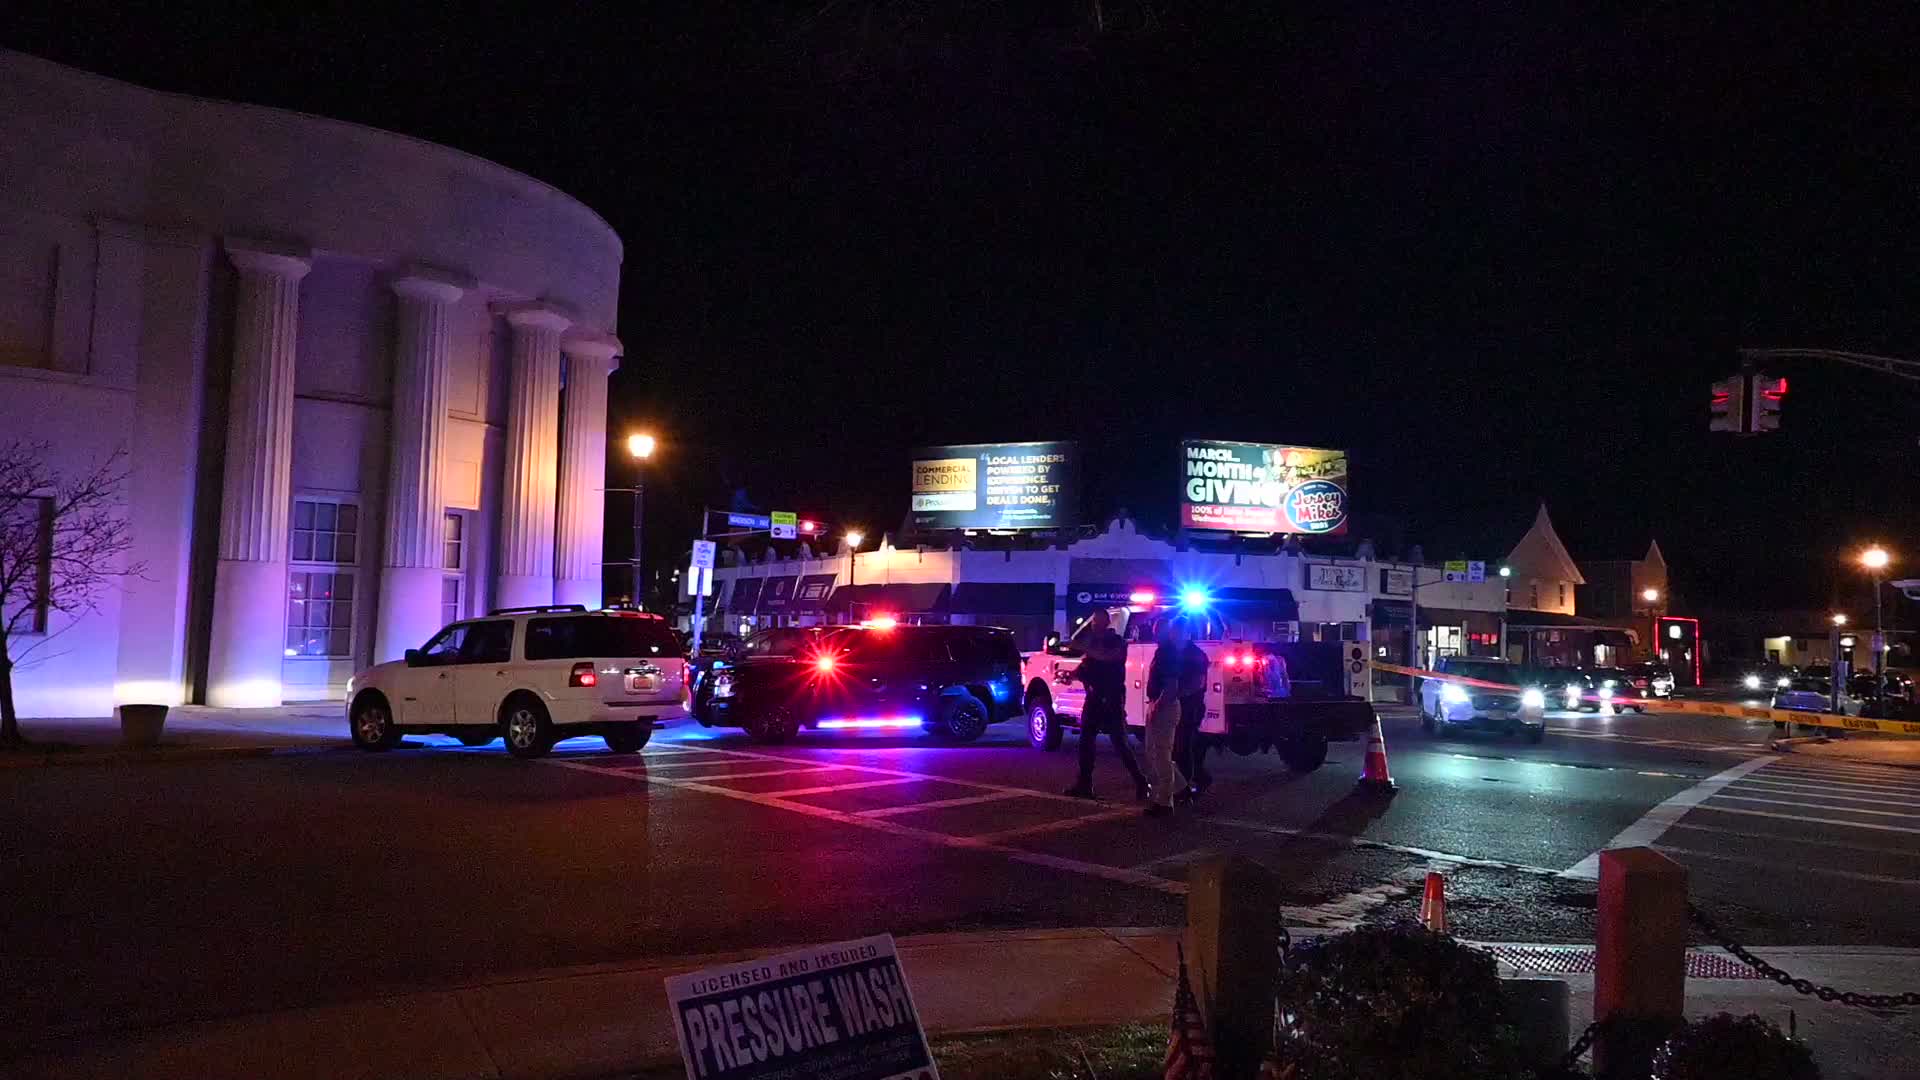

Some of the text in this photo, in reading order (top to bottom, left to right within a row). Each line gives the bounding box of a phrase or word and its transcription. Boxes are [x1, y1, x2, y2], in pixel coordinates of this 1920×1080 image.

[1021, 454, 1065, 463] LENDERS
[917, 465, 971, 474] COMMERCIAL
[1038, 465, 1050, 473] BY
[1187, 461, 1253, 480] MONTH
[986, 476, 1048, 485] EXPENCE.
[1026, 485, 1039, 494] TO
[1041, 484, 1060, 493] GET
[1186, 478, 1281, 507] GIVING
[986, 496, 1018, 505] DEALS
[1294, 489, 1341, 508] Jersey
[1191, 506, 1213, 517] 100%
[1842, 718, 1879, 730] CAUTION
[691, 945, 878, 995] LICENSED AND INSURED
[684, 980, 839, 1077] PRESSURE
[831, 963, 913, 1038] WASH
